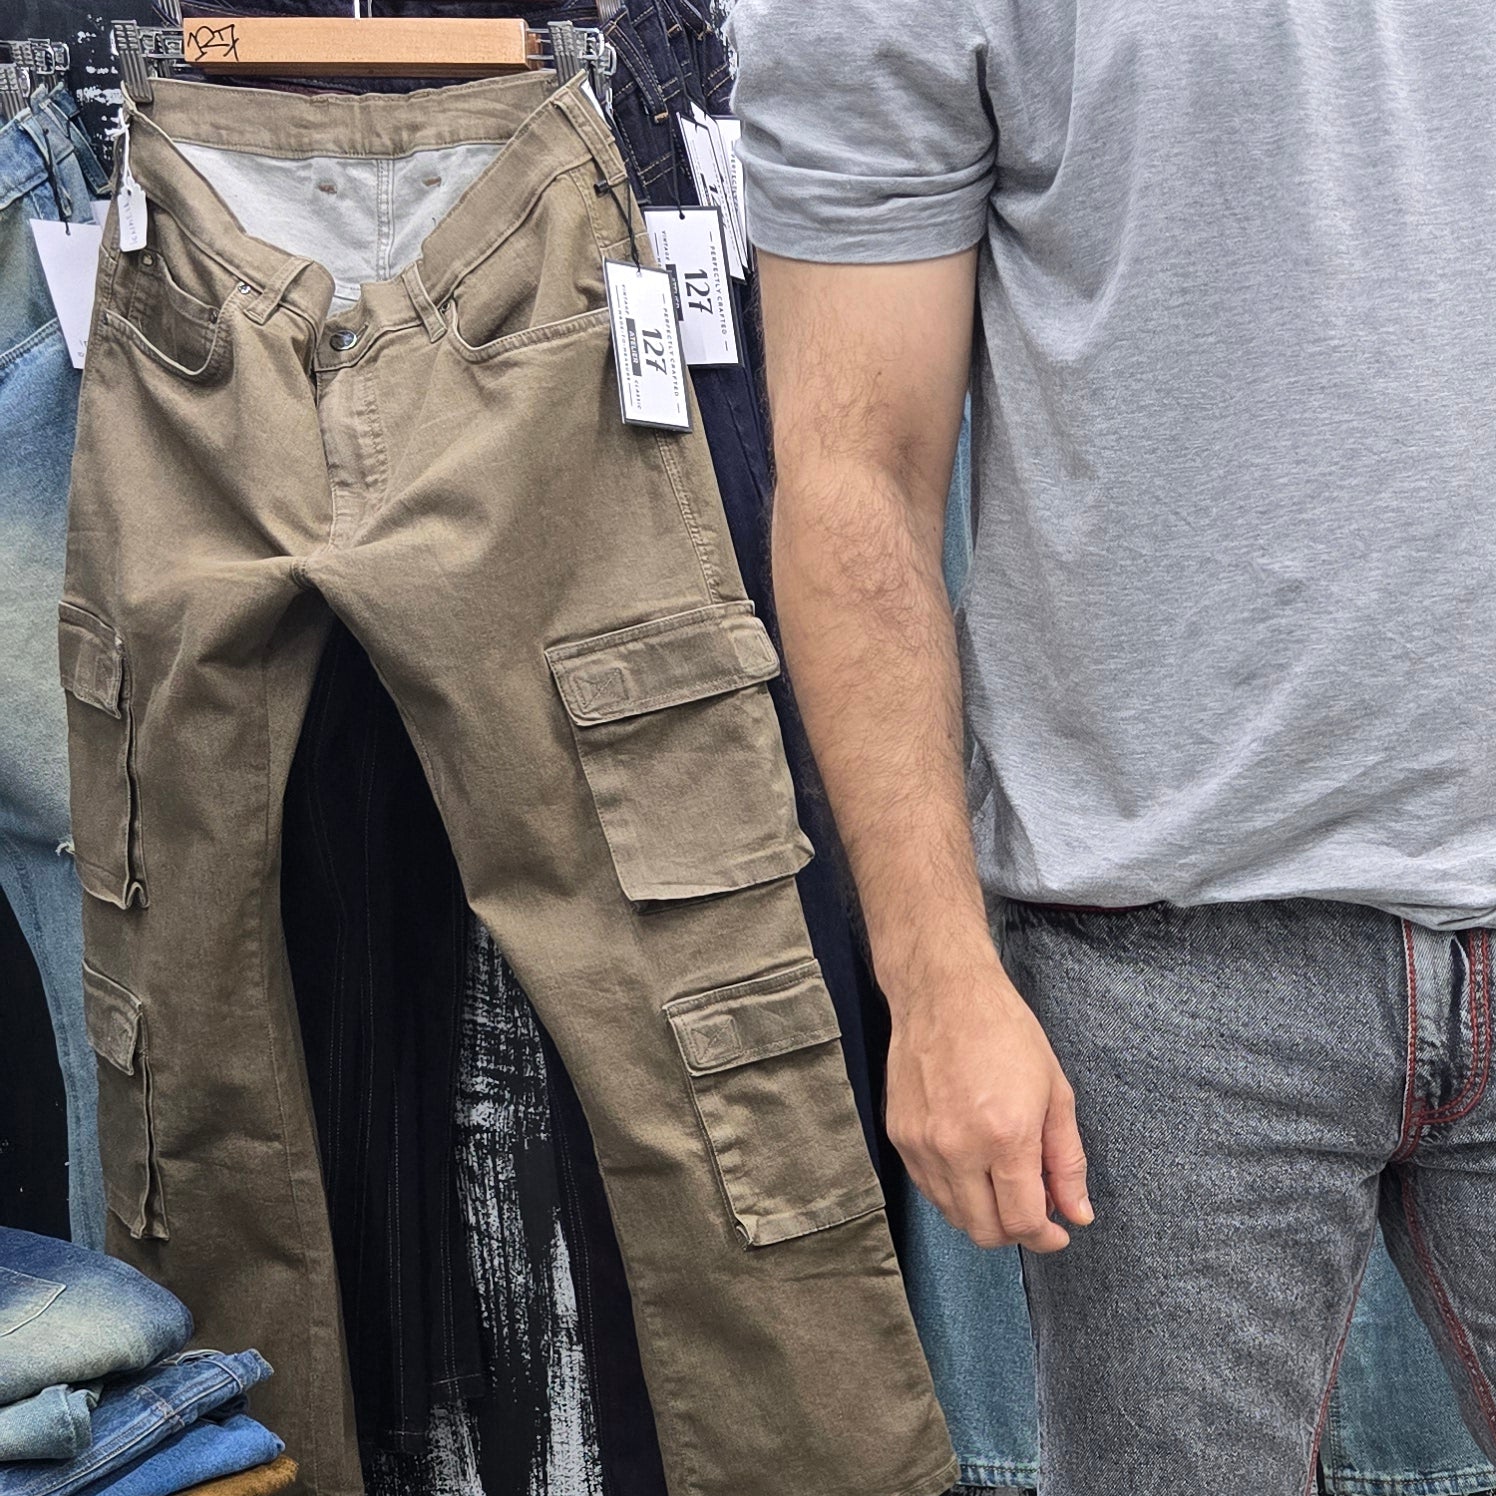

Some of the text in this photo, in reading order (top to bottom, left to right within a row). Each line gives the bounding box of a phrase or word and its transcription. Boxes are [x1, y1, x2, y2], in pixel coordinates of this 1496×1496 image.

[684, 268, 713, 315] 127
[710, 245, 728, 336] PERFECTLY CRAFTED
[628, 330, 639, 365] ATELIER
[642, 328, 668, 375] 127
[663, 307, 680, 397] PERFECTLY CRAFTED
